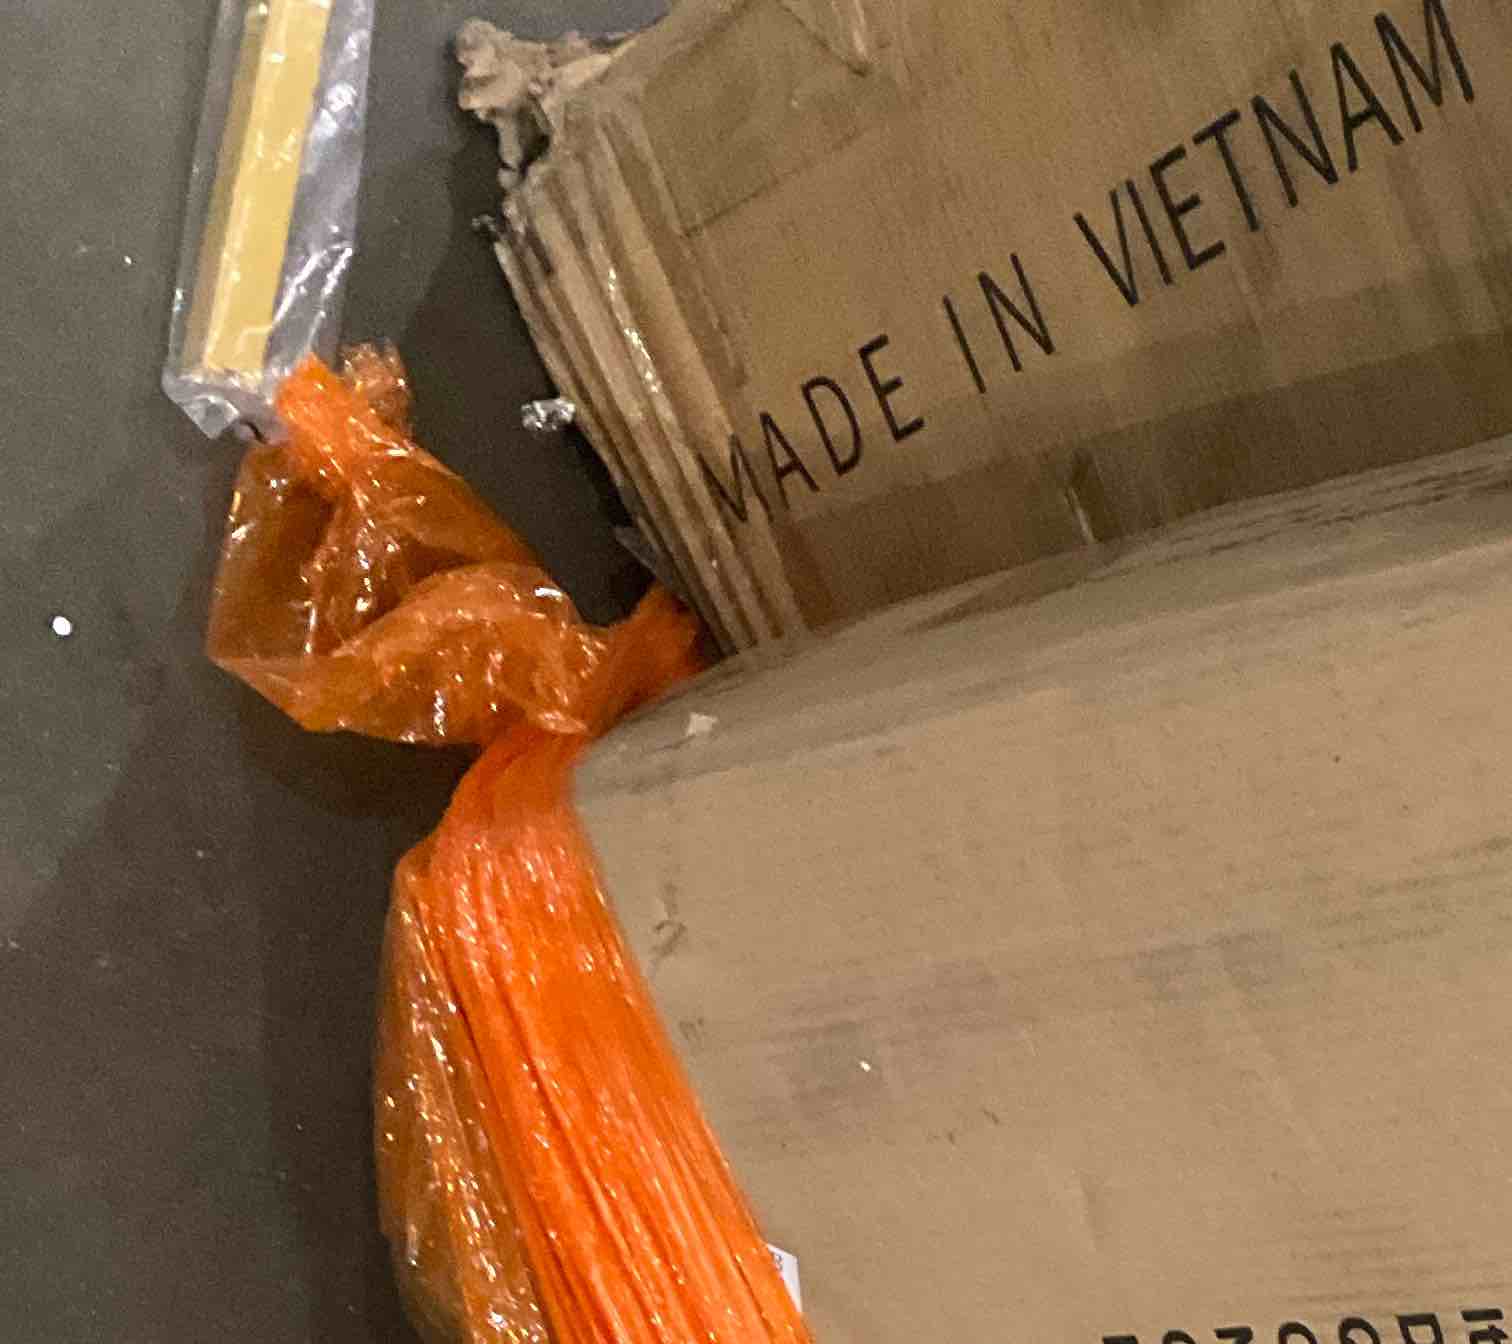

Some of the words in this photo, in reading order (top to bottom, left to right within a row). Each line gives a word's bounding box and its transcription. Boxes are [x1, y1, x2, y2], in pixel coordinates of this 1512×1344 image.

[697, 334, 925, 525] MADE
[943, 253, 1055, 394] IN
[1072, 0, 1475, 308] VIETNAM
